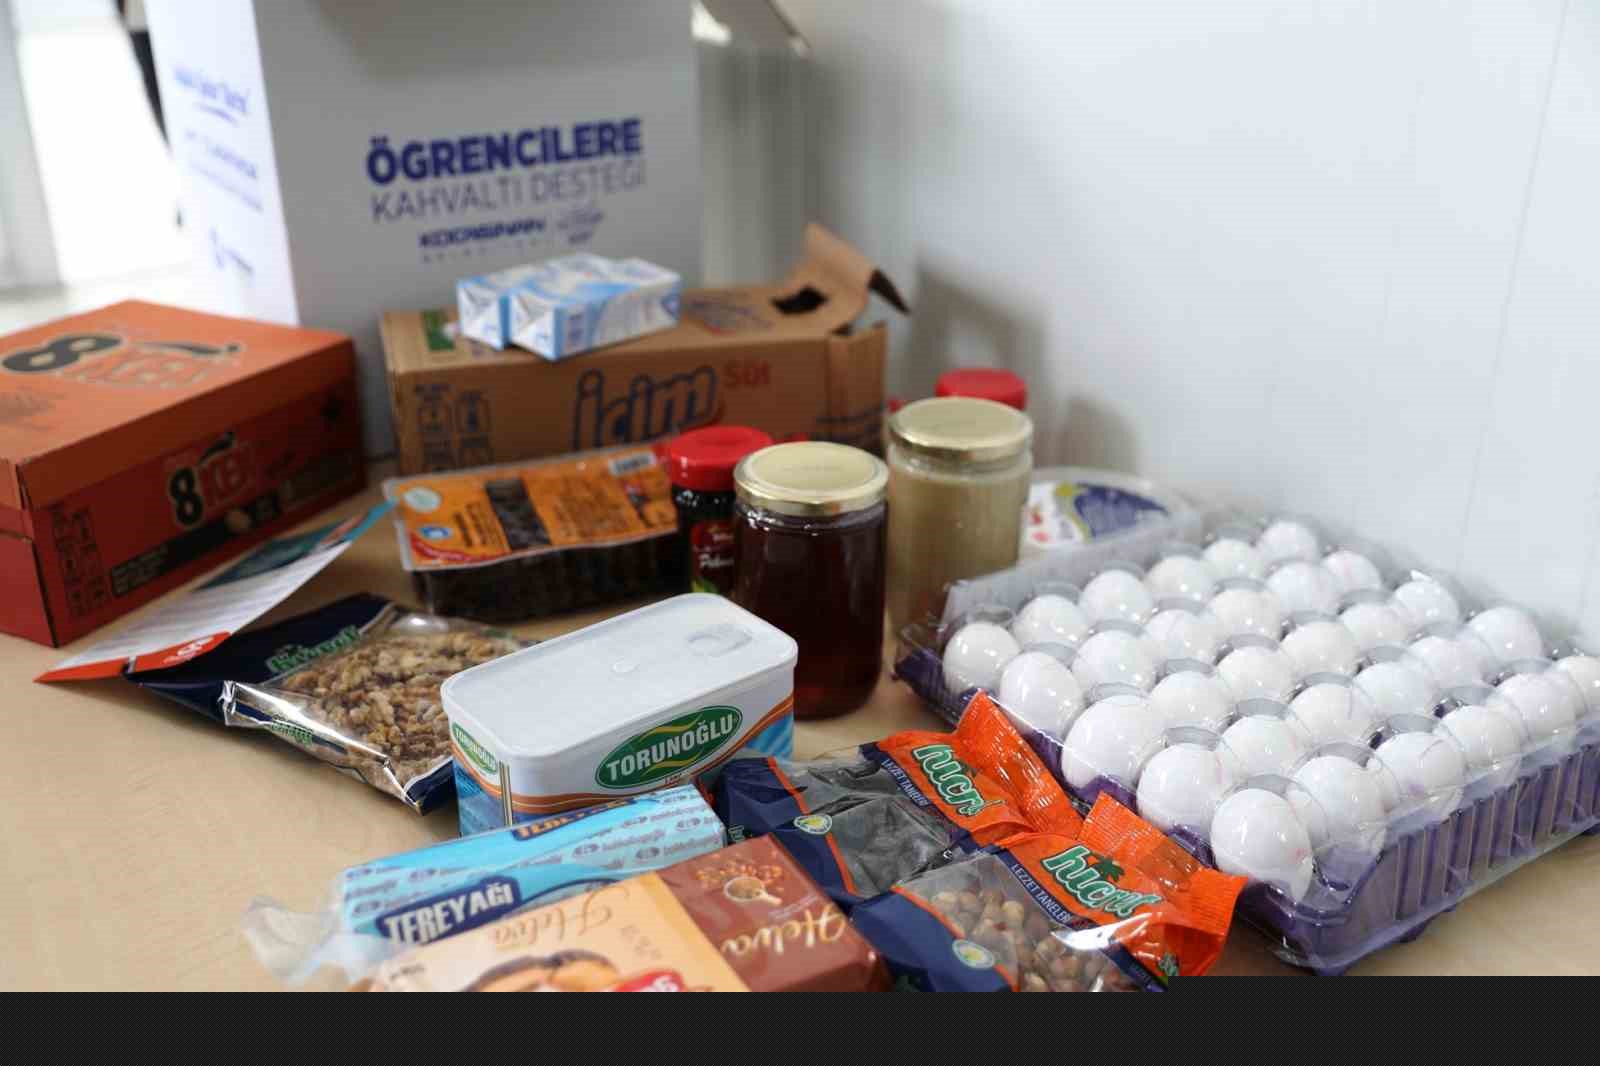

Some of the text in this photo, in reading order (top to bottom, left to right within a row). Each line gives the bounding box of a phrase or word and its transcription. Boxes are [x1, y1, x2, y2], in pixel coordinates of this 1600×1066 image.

[370, 176, 523, 223] KAHVALTI
[606, 713, 735, 783] TORUNOĞLU
[721, 903, 848, 957] Helva
